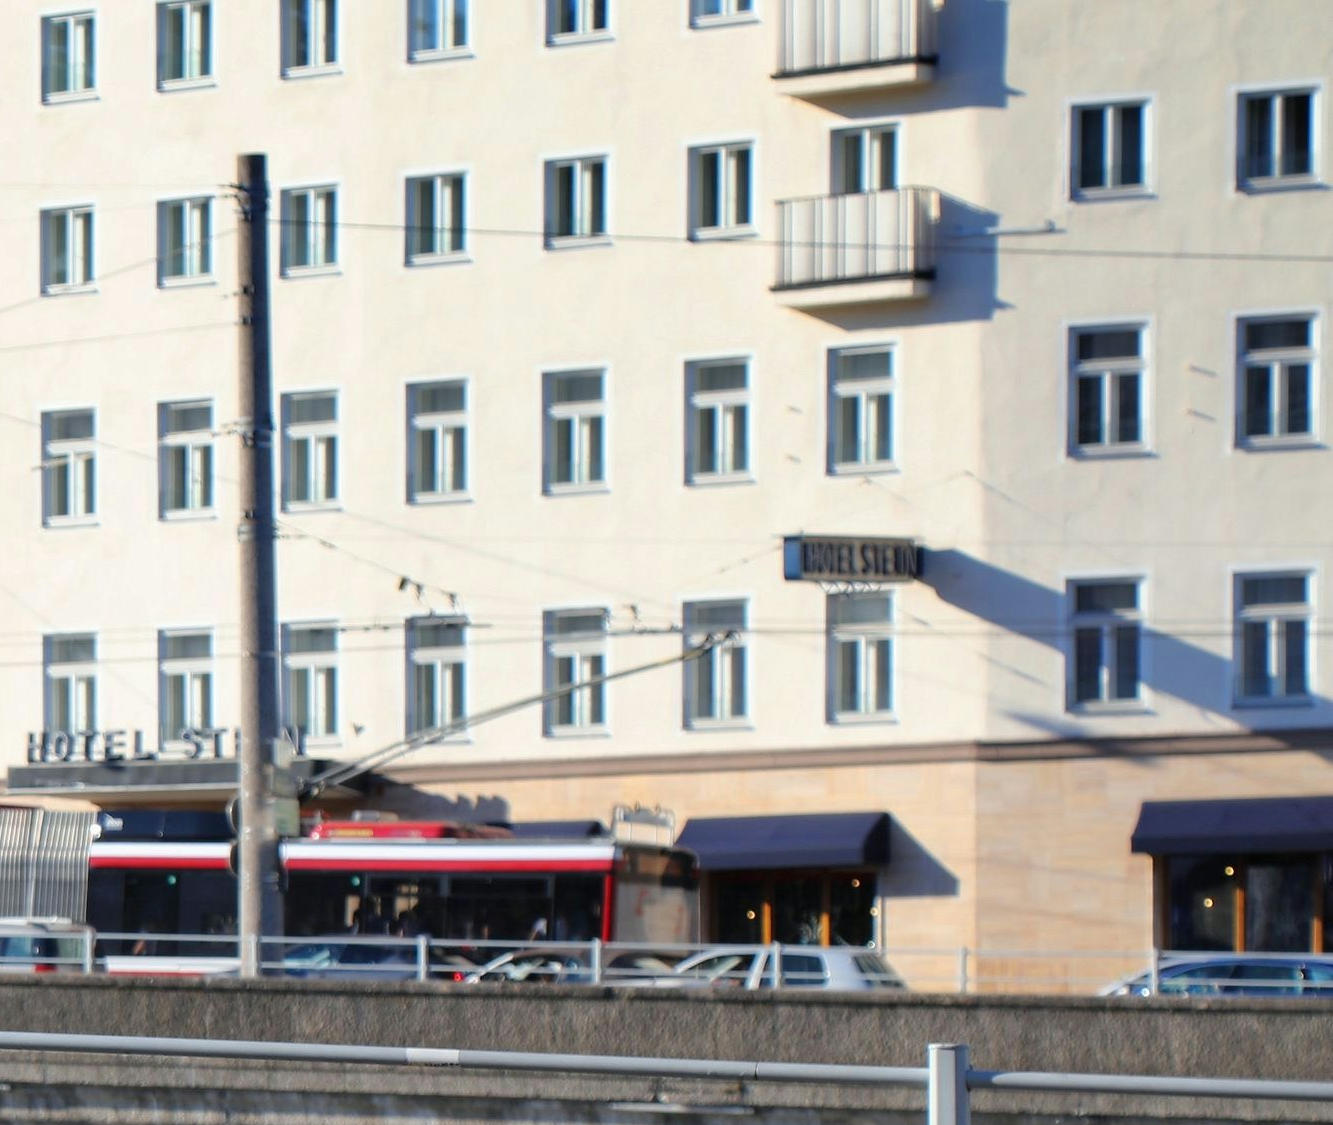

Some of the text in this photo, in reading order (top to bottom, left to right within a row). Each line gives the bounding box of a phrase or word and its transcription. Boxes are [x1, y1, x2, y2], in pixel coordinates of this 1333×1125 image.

[803, 542, 919, 577] HOTEL STEIN
[28, 730, 159, 763] HOTEL
